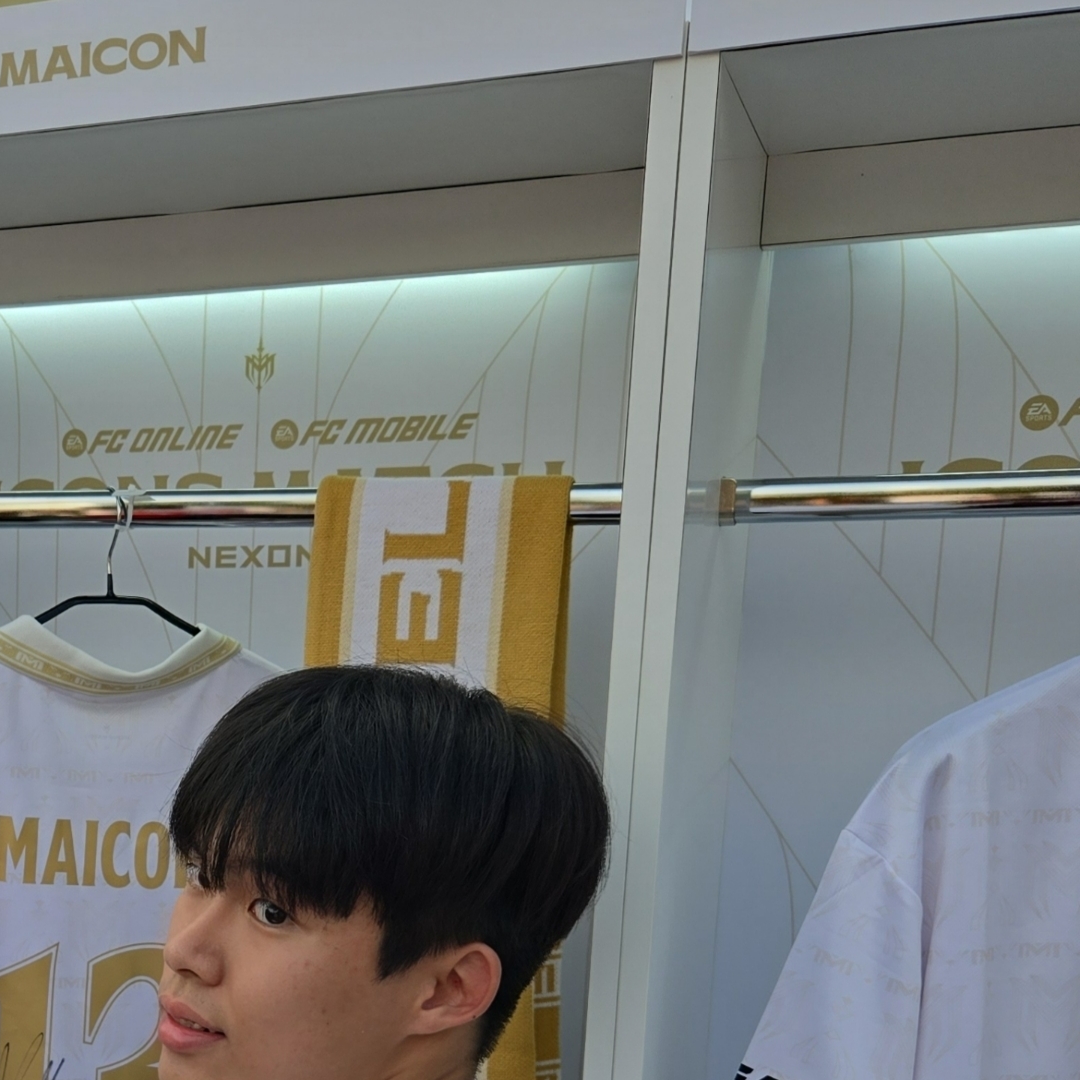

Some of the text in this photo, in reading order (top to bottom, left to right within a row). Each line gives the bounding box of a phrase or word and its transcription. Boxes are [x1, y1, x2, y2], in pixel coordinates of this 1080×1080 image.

[88, 424, 244, 454] FC ONLINE
[299, 412, 479, 446] FC MOBILE
